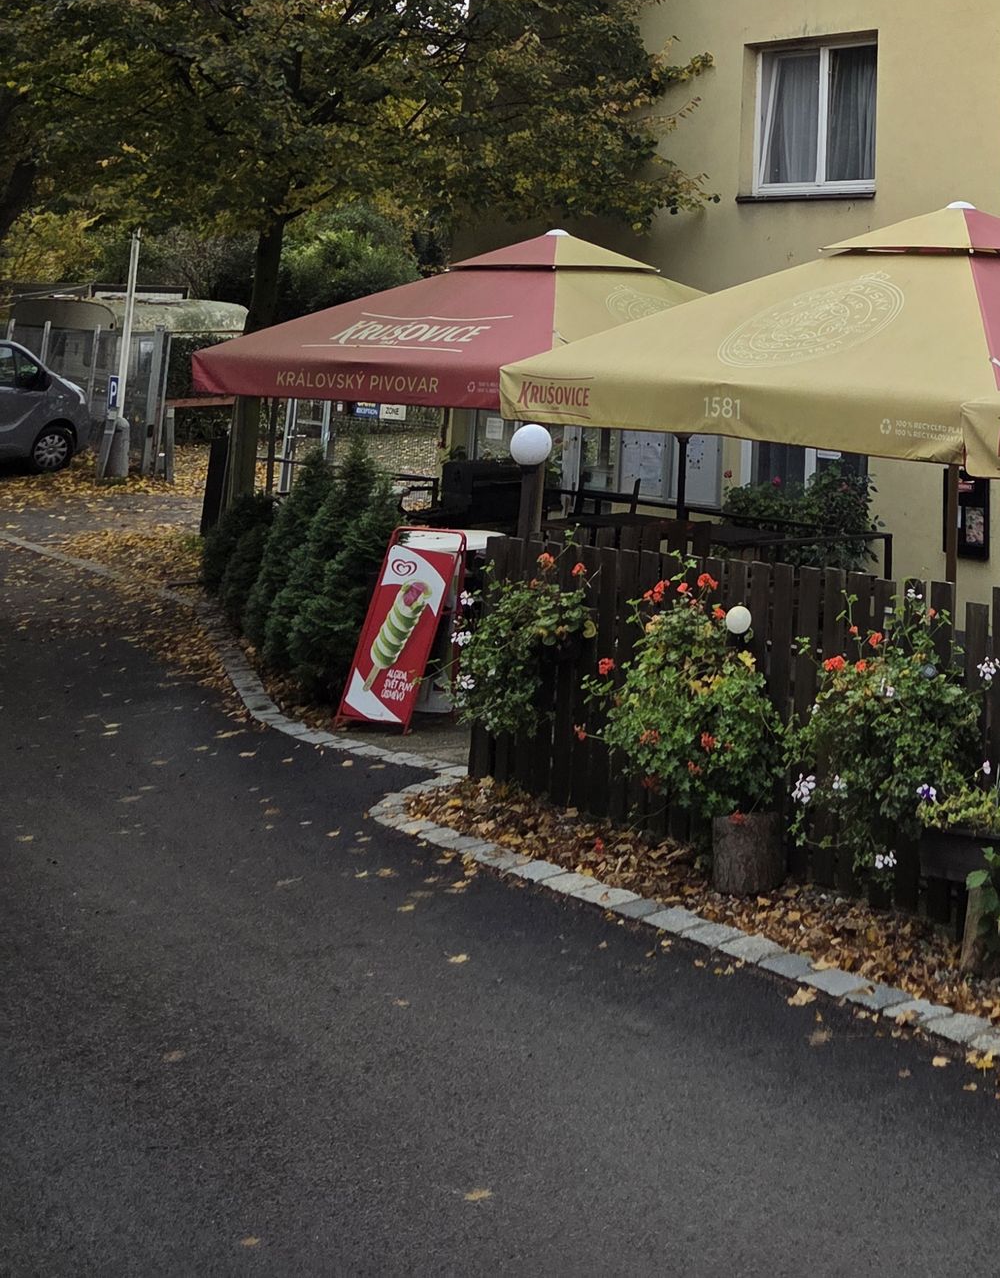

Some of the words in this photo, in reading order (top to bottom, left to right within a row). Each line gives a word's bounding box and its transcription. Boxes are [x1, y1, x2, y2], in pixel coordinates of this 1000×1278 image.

[329, 320, 492, 345] KRUŠOVICE
[110, 381, 117, 405] P
[276, 368, 366, 389] KRÁLOVSKÝ
[369, 374, 439, 393] PIVOVAR
[517, 380, 590, 409] KRUŠOVICE
[703, 396, 742, 420] 1581
